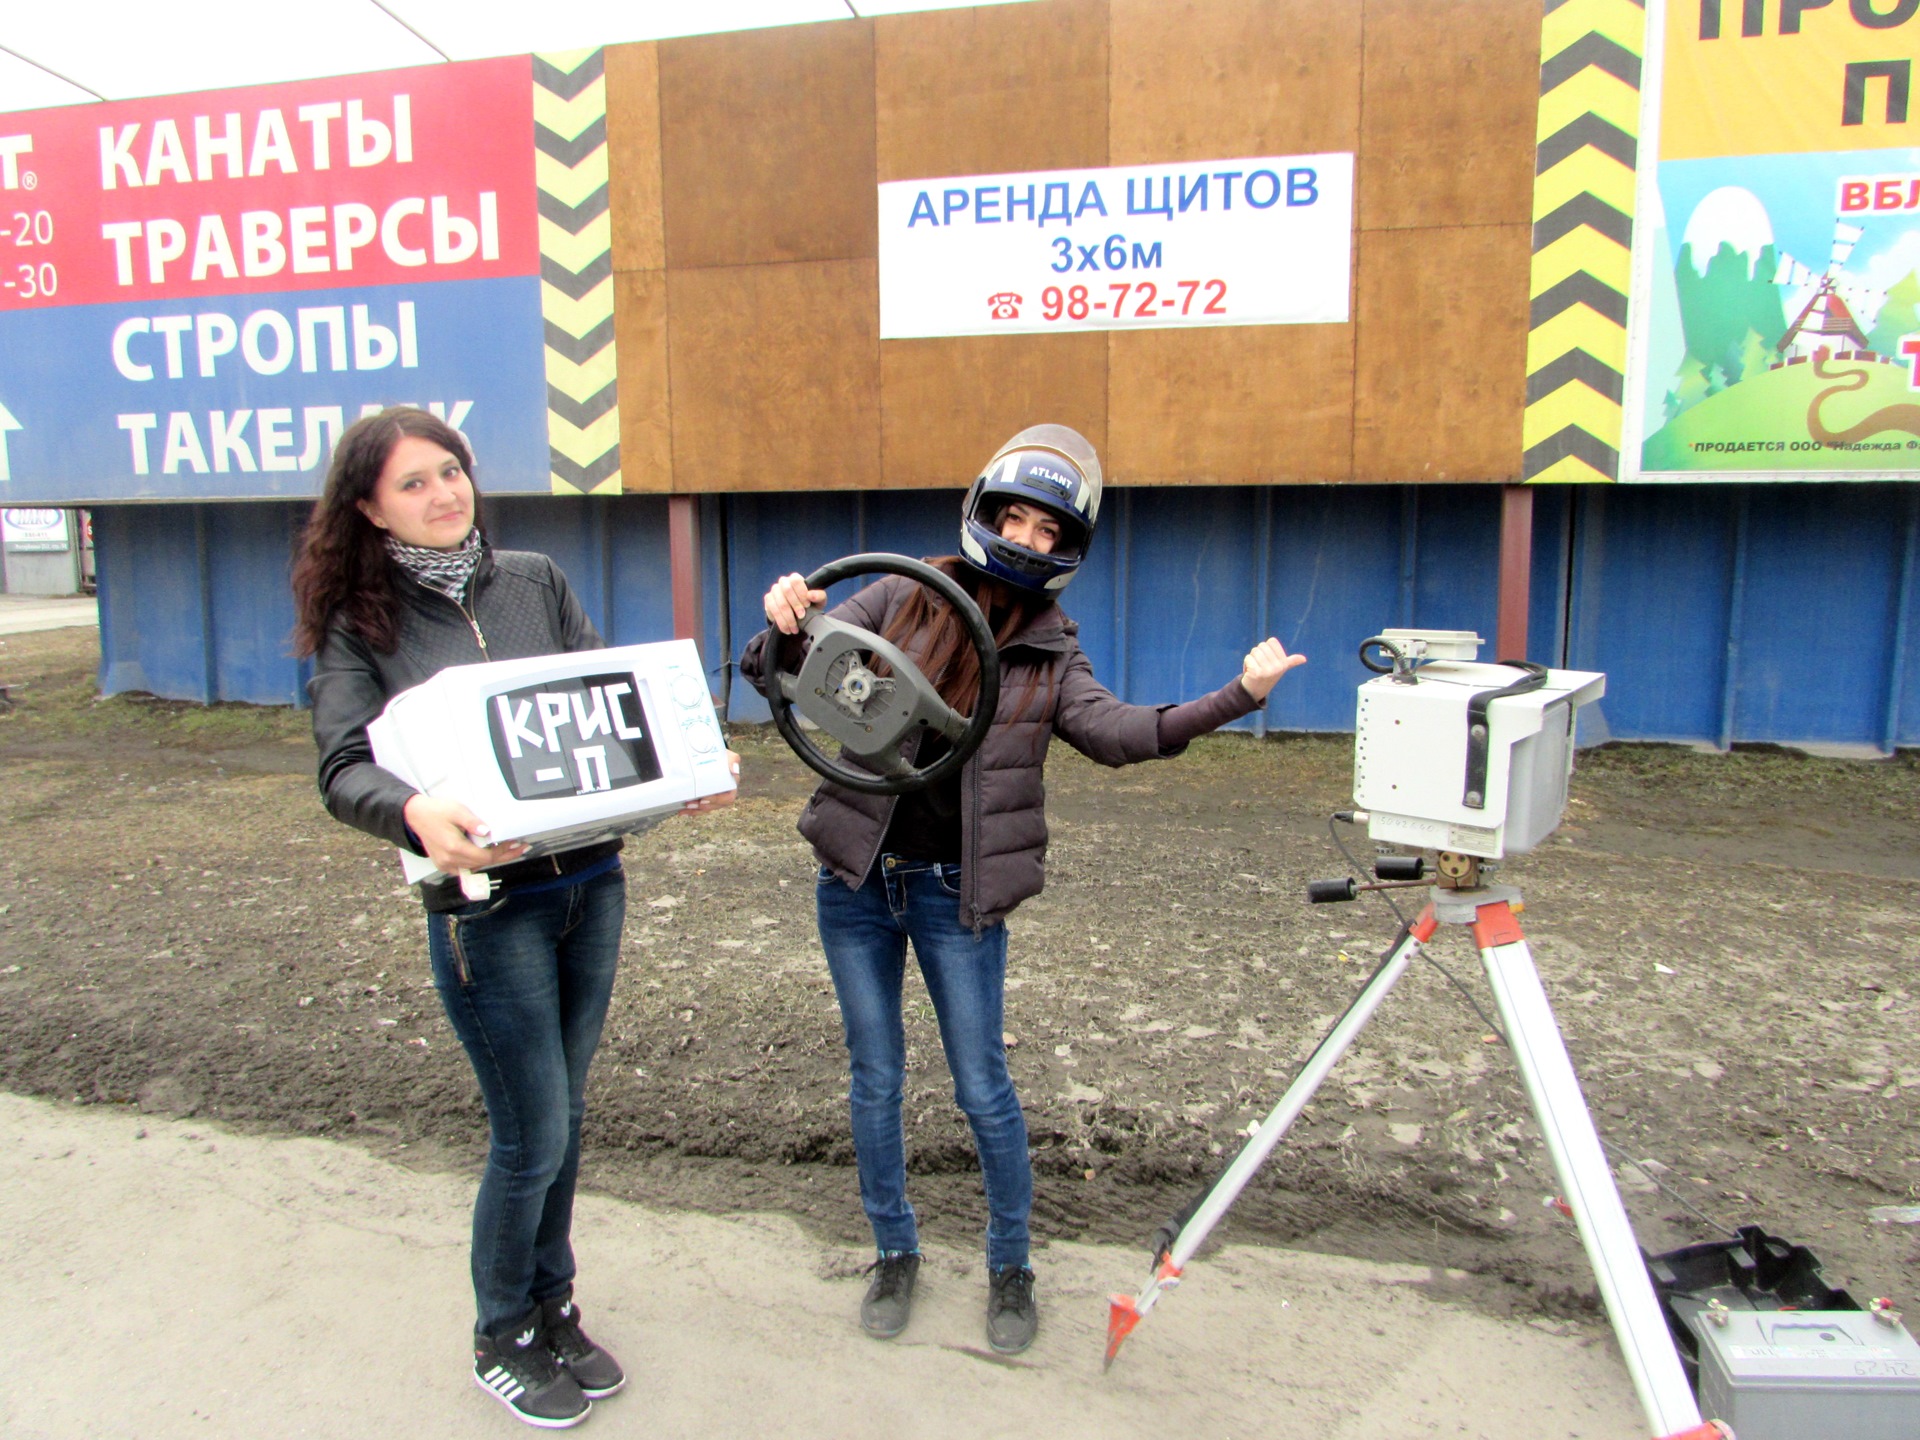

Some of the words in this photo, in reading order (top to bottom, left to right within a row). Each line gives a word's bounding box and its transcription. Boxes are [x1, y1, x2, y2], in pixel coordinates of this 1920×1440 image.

[1841, 59, 1911, 126] П
[99, 94, 413, 190] КАНАТЫ
[907, 181, 1108, 228] АРЕНДА
[1126, 167, 1319, 221] ЩИТОВ
[102, 191, 500, 286] ТРАВЕРСЫ
[1050, 234, 1163, 273] 3х6м
[1040, 279, 1228, 321] 98-72-72
[111, 301, 418, 382] СТРОПЫ
[117, 400, 479, 475] ТАКЕЛ
[1789, 441, 1822, 452] ООО
[1030, 466, 1073, 489] ATLANT
[496, 682, 642, 758] КРИС
